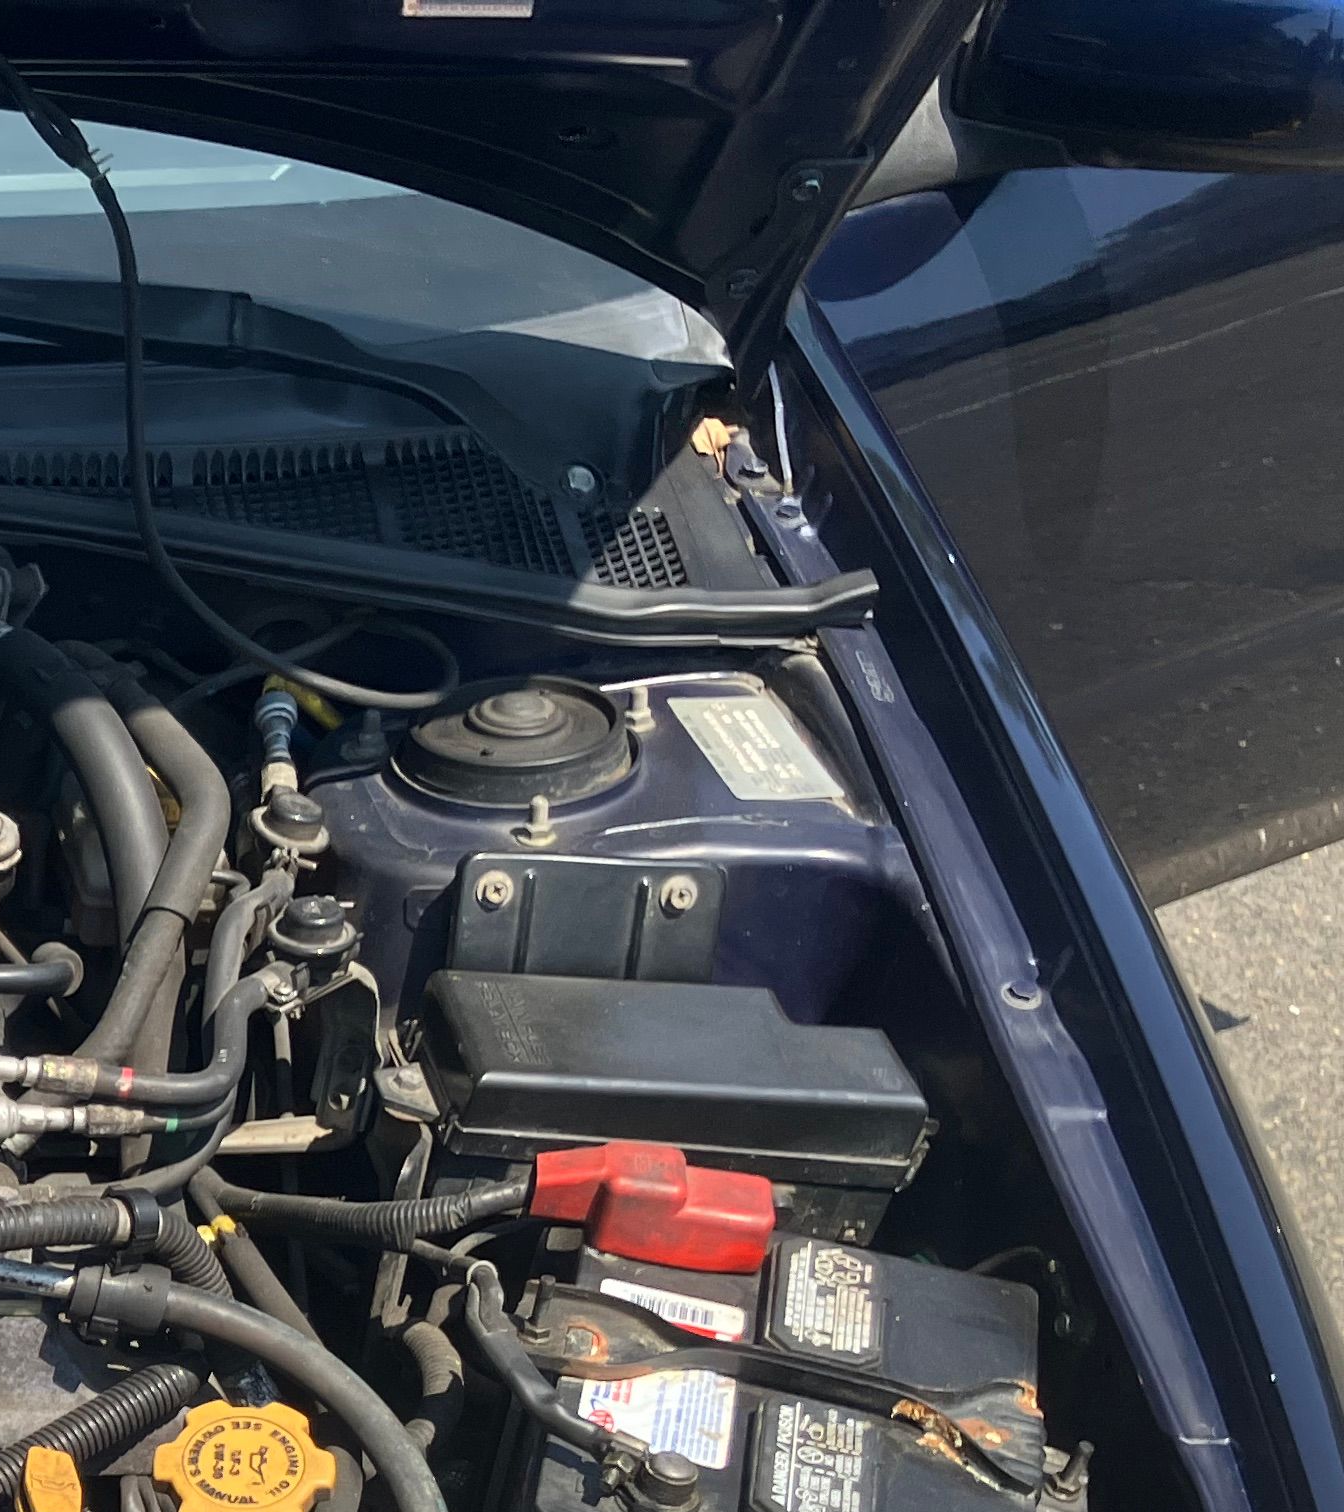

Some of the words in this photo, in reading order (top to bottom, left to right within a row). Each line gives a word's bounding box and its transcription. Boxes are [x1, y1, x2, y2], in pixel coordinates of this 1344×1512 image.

[231, 1421, 262, 1431] SEE
[269, 1429, 299, 1477] ENGINE
[196, 1479, 259, 1504] MANUAL
[266, 1480, 290, 1497] OIL
